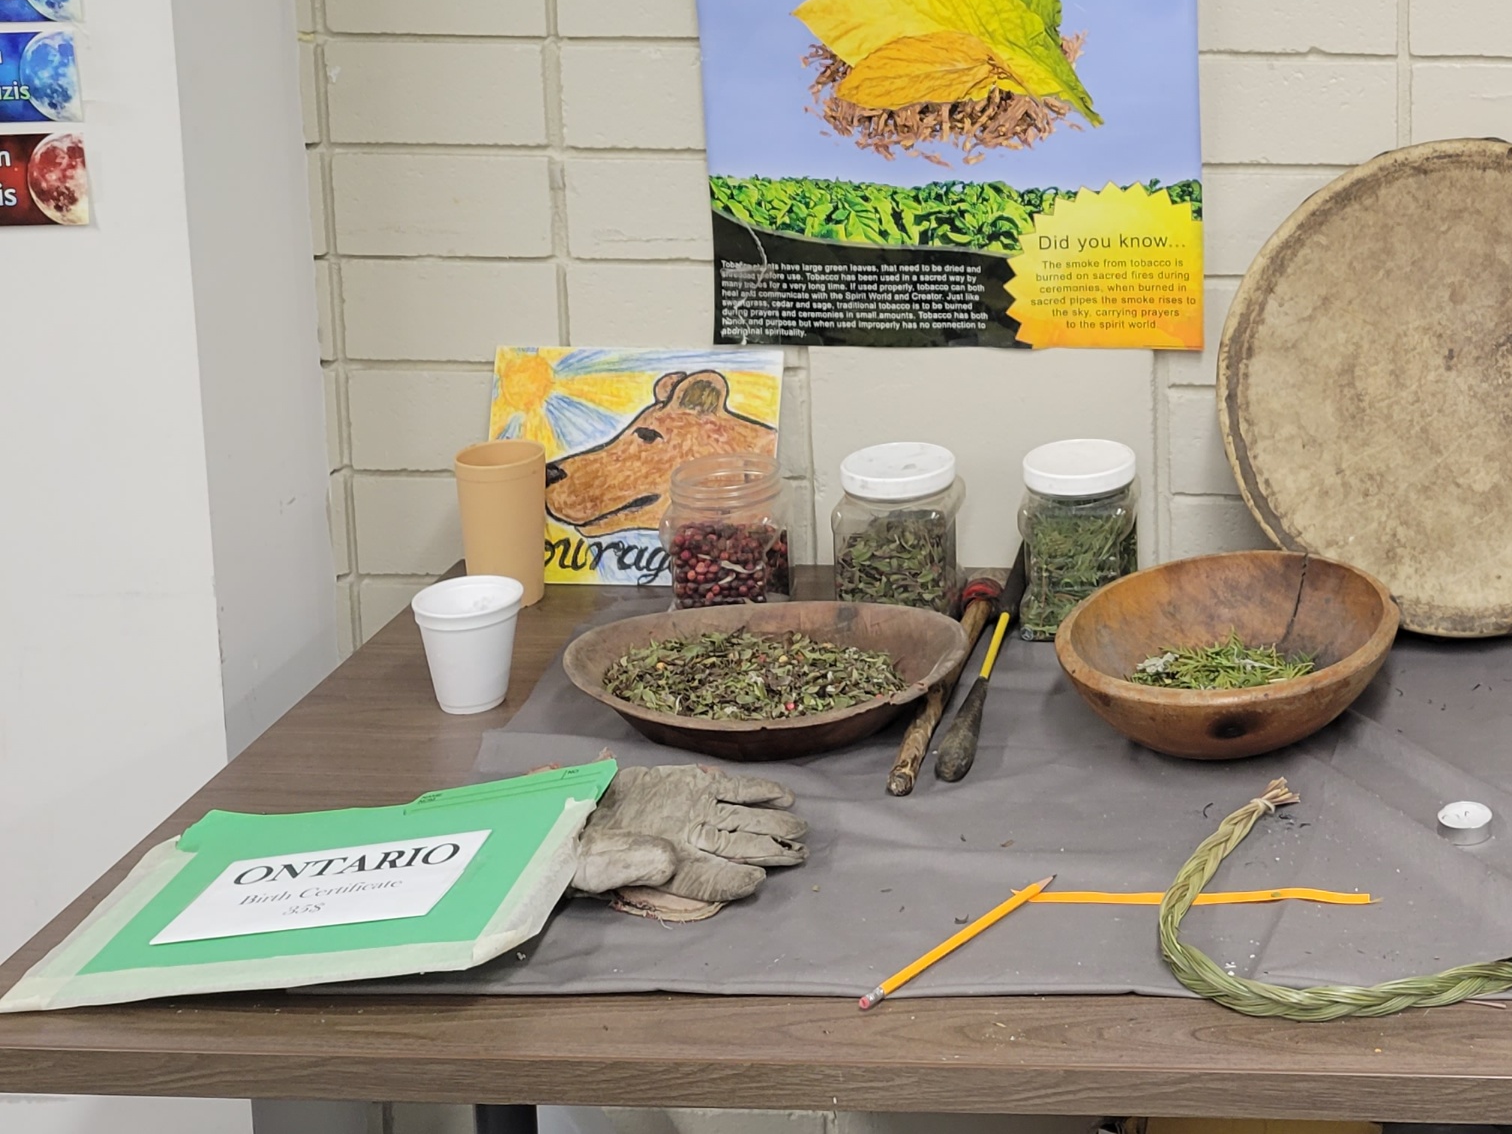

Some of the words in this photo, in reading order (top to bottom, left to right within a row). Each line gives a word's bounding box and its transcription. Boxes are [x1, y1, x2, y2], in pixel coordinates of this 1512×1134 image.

[1039, 235, 1069, 249] Did
[1077, 238, 1110, 253] you
[1119, 234, 1186, 248] know...
[1041, 261, 1061, 269] The
[1065, 260, 1099, 269] smoke
[1103, 259, 1126, 268] from
[1130, 258, 1171, 267] tobacco
[1174, 258, 1183, 267] is
[1036, 272, 1072, 282] burned
[1092, 272, 1127, 281] sacred
[1131, 271, 1153, 280] fires
[1157, 271, 1190, 282] during
[1106, 283, 1134, 293] when
[1138, 283, 1174, 292] burned
[1177, 283, 1187, 291] in
[1030, 297, 1065, 306] sacred
[1069, 297, 1097, 308] pipes
[1101, 296, 1117, 305] the
[1120, 296, 1154, 305] smoke
[1158, 296, 1182, 305] rises
[1186, 296, 1196, 304] to
[1052, 308, 1068, 316] the
[1095, 308, 1137, 318] carrying
[1140, 309, 1180, 318] prayers
[1066, 320, 1076, 328] to
[1079, 320, 1095, 328] the
[1099, 320, 1124, 330] spirit
[764, 327, 807, 338] spirituality.
[545, 538, 671, 585] ourag
[234, 843, 460, 885] ONTARIO
[239, 891, 291, 905] Birth
[299, 879, 403, 899] Certificate
